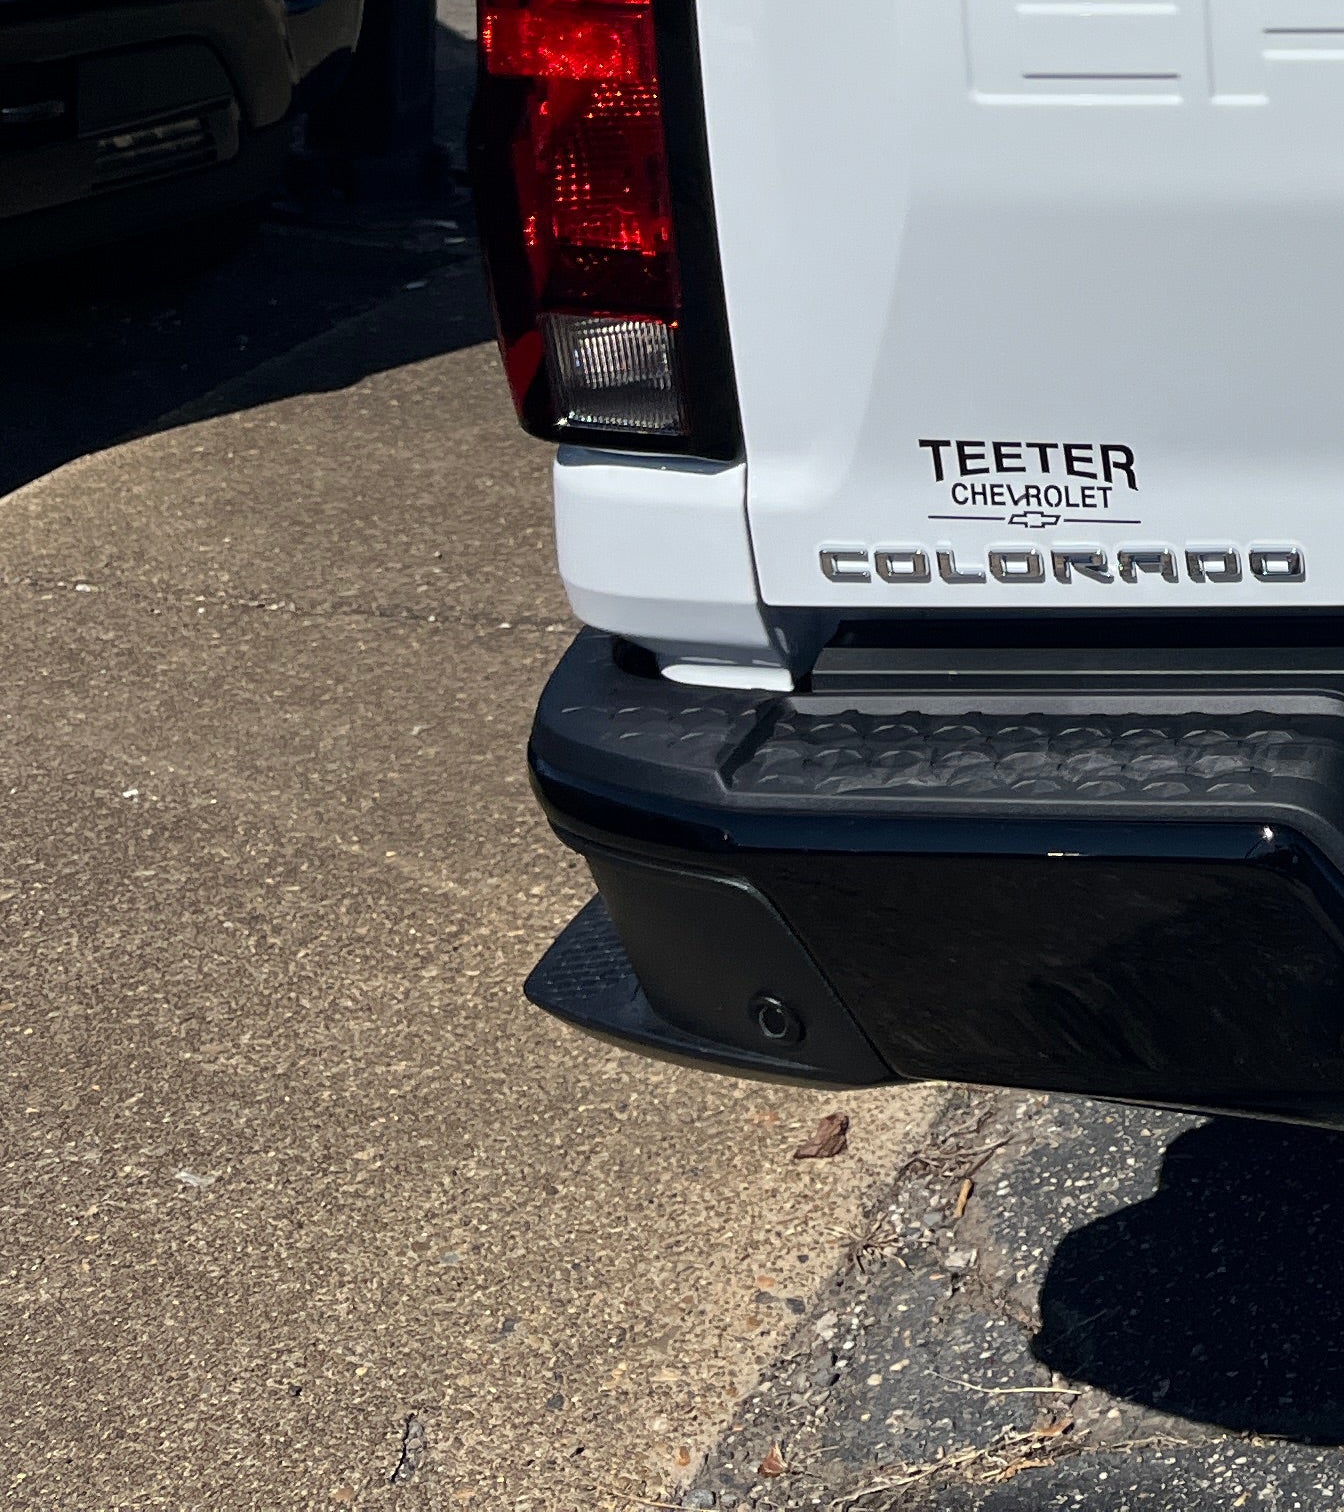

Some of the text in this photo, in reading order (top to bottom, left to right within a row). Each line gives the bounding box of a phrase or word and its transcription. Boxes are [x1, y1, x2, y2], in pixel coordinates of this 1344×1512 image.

[918, 438, 1139, 491] TEETER
[950, 481, 1113, 509] CHEVROLET
[818, 544, 1306, 585] COLORADO
